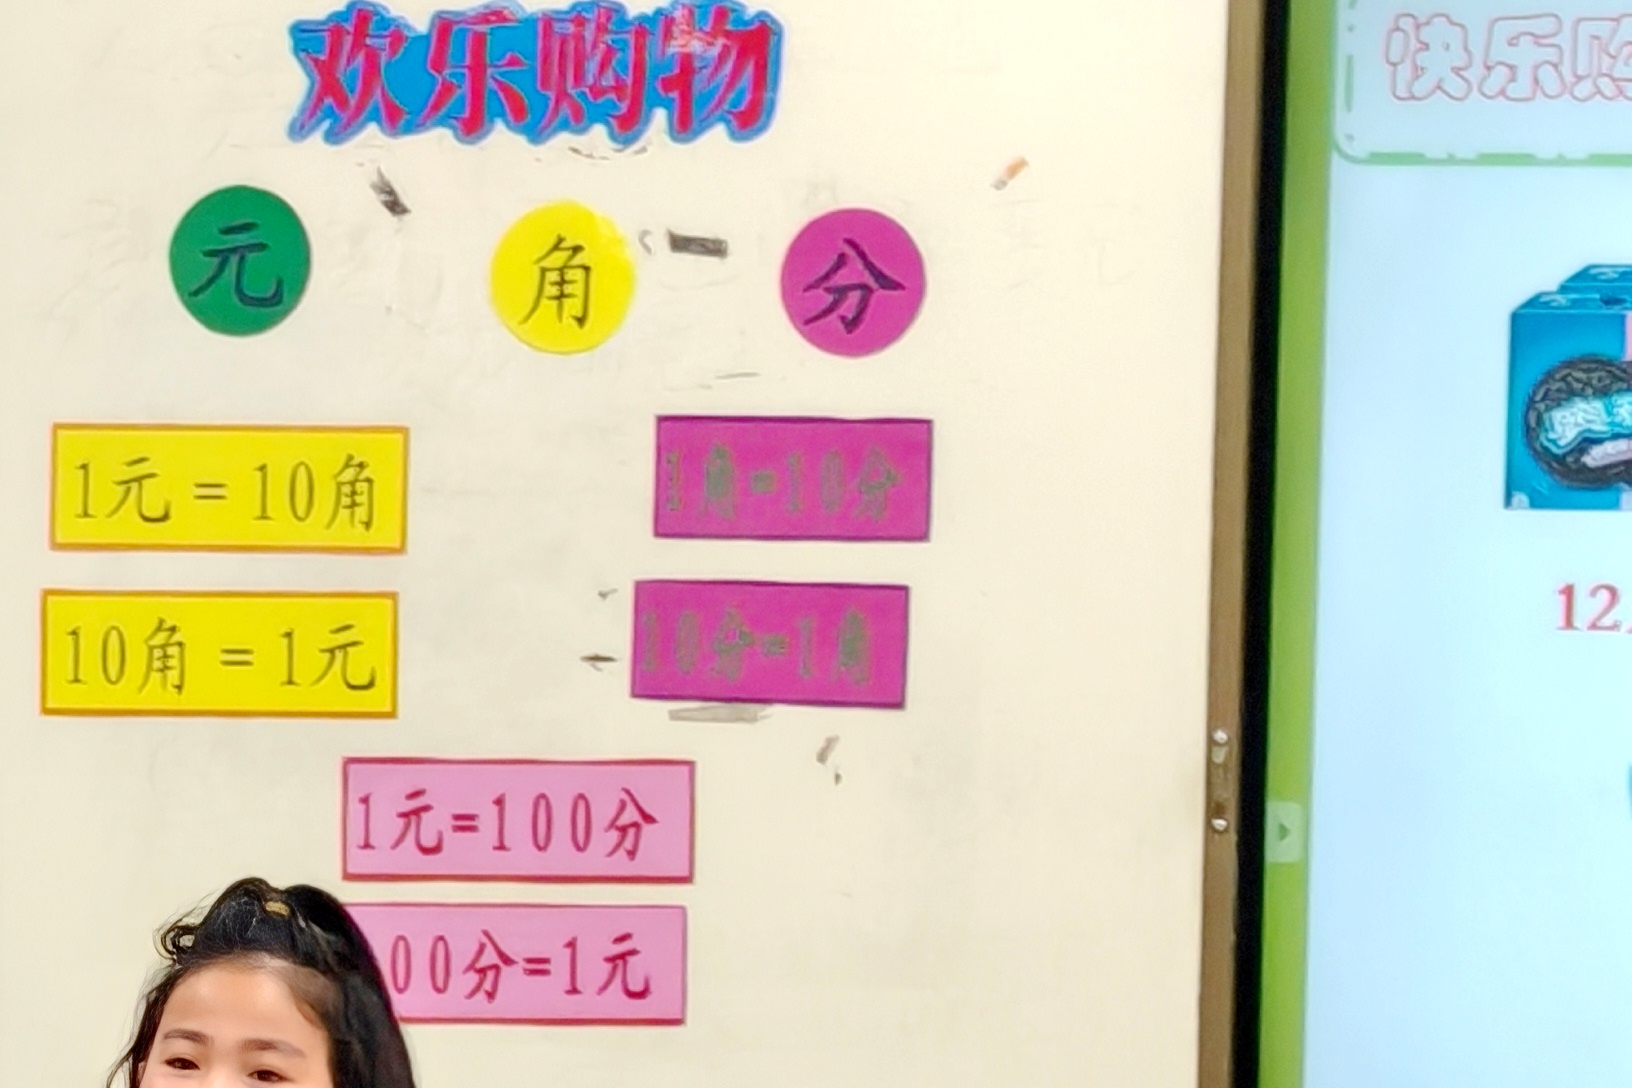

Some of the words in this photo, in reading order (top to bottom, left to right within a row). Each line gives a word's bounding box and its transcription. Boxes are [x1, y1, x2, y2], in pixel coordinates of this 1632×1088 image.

[298, 3, 776, 140] 欢乐购物
[188, 221, 285, 308] 元
[518, 233, 595, 330] 角
[802, 237, 904, 334] 分
[1555, 582, 1632, 634] 12
[355, 787, 660, 861] 1元=100分
[390, 928, 652, 1004] 00分=1元
